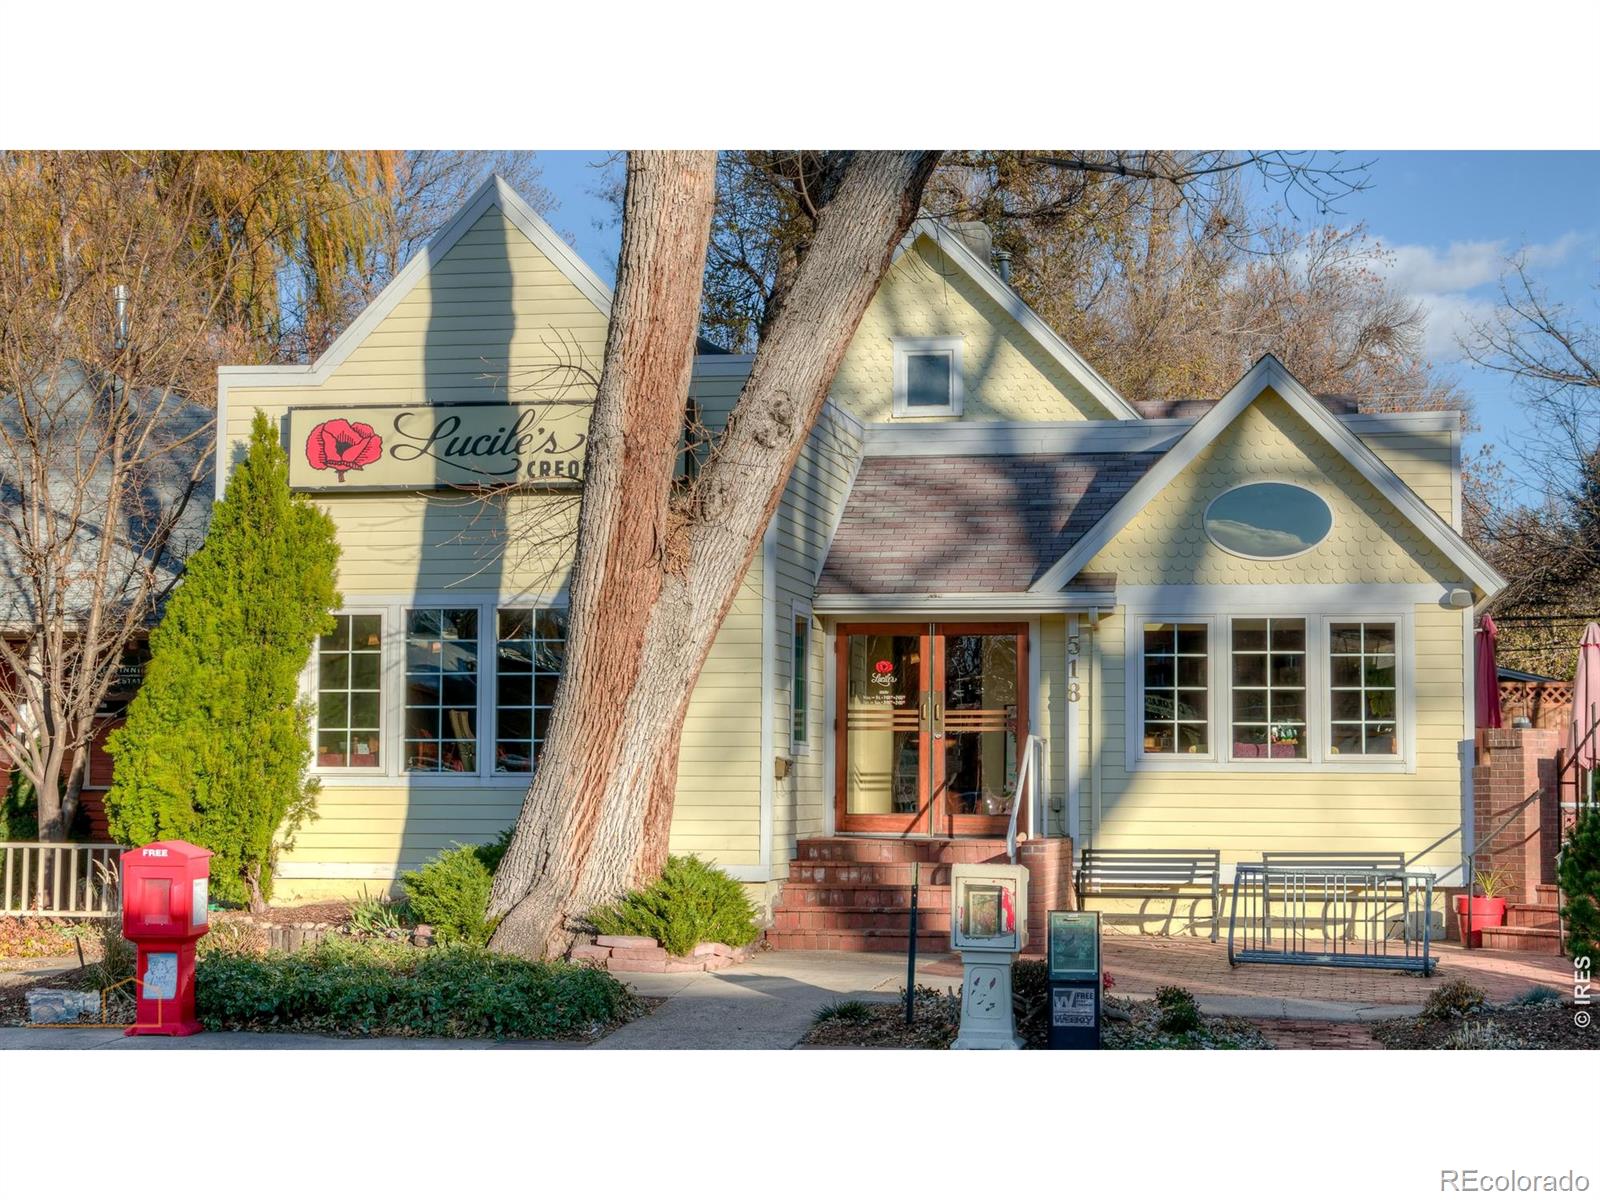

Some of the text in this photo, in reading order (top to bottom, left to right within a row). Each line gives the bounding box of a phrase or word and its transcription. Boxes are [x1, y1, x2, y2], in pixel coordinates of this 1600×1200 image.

[389, 408, 587, 475] Lucile's
[527, 459, 580, 477] CREO
[1067, 635, 1081, 702] 518
[142, 849, 169, 857] FREE
[1076, 992, 1094, 1000] FREE
